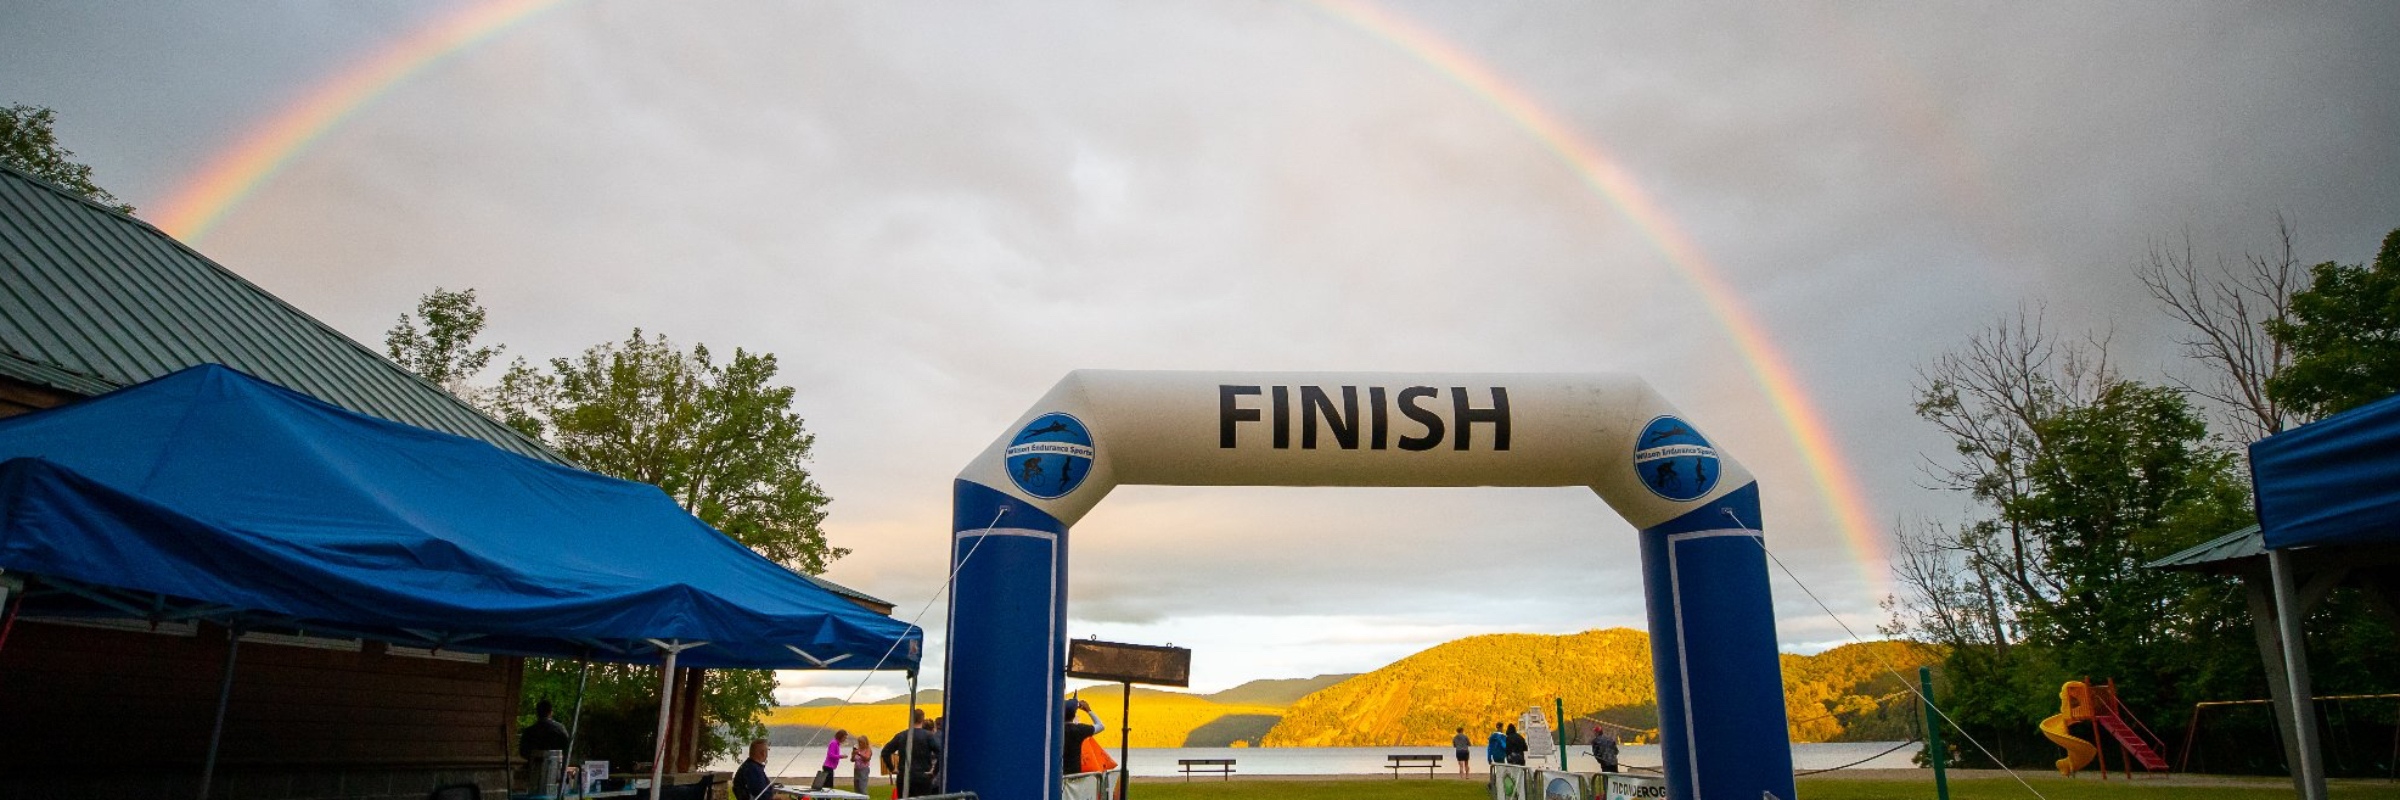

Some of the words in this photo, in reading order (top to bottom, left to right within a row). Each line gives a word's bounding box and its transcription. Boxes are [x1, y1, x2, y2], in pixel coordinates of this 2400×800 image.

[1219, 385, 1511, 451] FINISH
[1031, 444, 1068, 452] Endurance
[1070, 446, 1093, 456] Sports
[1636, 451, 1661, 460] Wilson
[1662, 446, 1697, 456] Endurance
[1612, 781, 1667, 798] TICONDEROG
